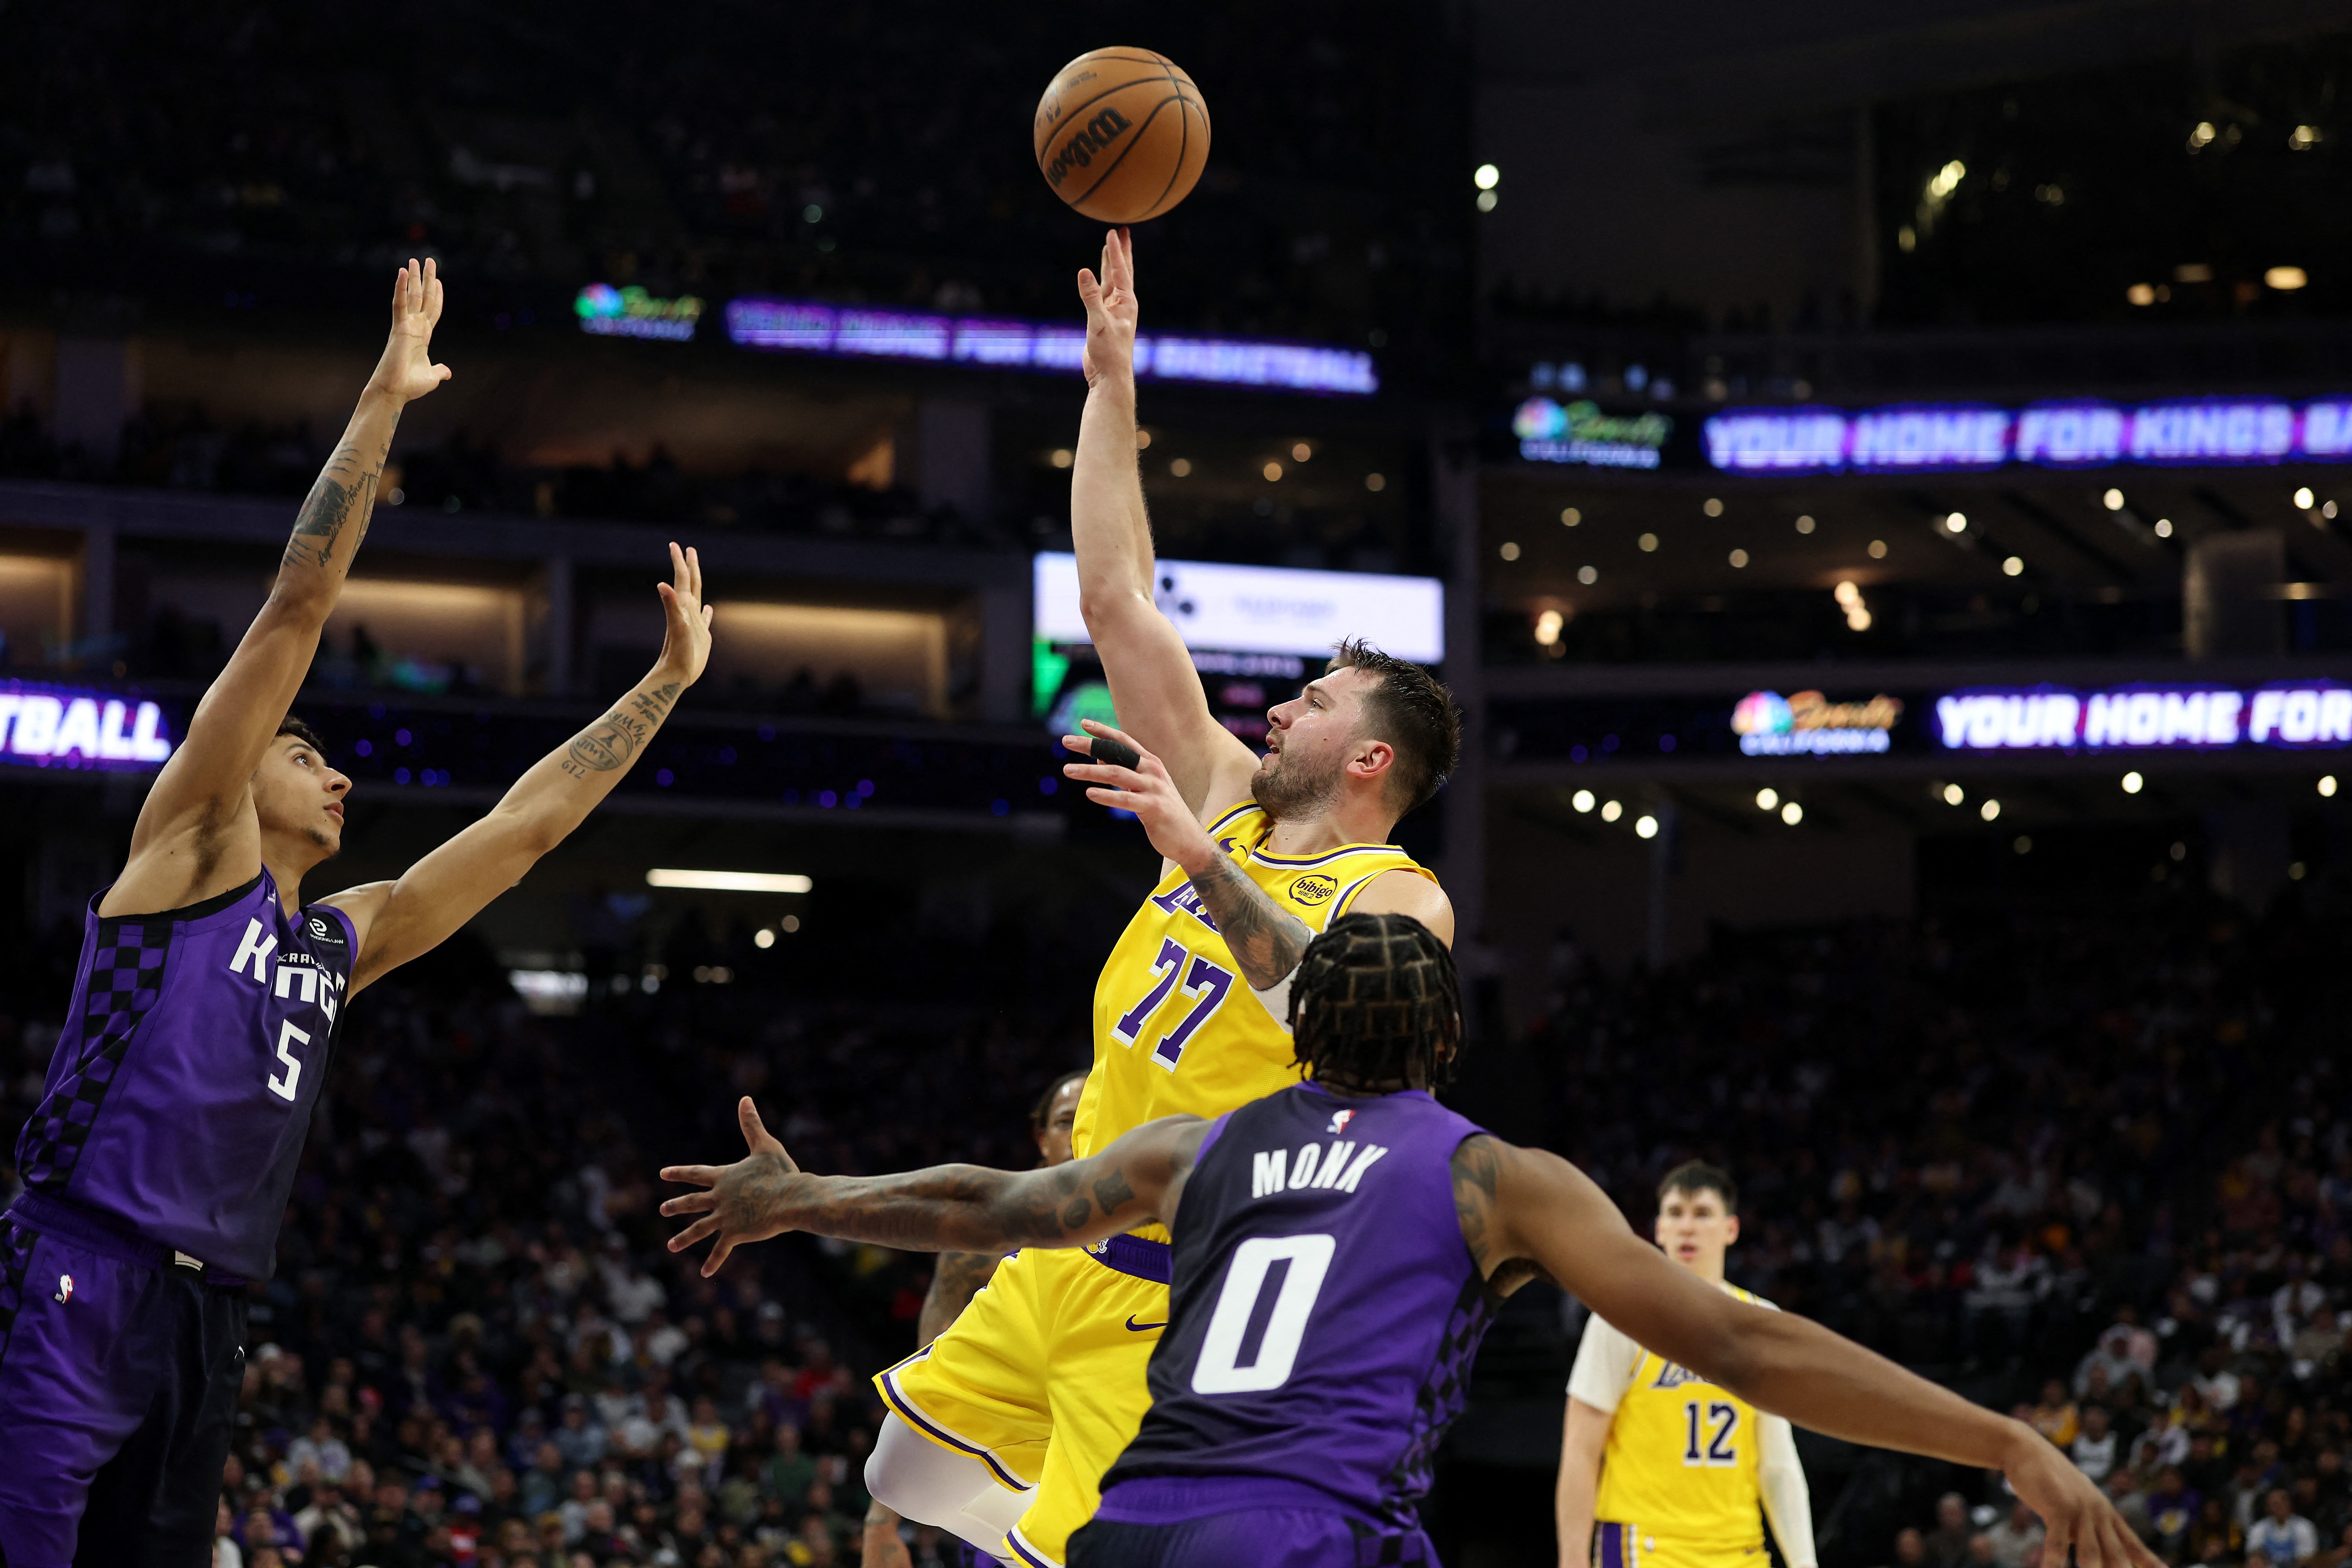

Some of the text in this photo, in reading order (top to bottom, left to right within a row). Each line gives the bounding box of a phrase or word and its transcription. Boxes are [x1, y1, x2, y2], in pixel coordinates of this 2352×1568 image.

[1048, 107, 1133, 188] Wilson
[1705, 414, 1847, 468] YOUR
[1852, 410, 2008, 464] HOME
[2014, 408, 2123, 461] FOR
[2134, 404, 2293, 459] KINGS
[1936, 689, 2352, 748] YOUR HOME FOR
[1296, 880, 1333, 898] bibigo
[1110, 934, 1236, 1074] 77
[268, 1018, 311, 1102] 5
[1252, 1140, 1388, 1199] MONK
[1191, 1233, 1337, 1394] 0
[1683, 1401, 1738, 1467] 12
